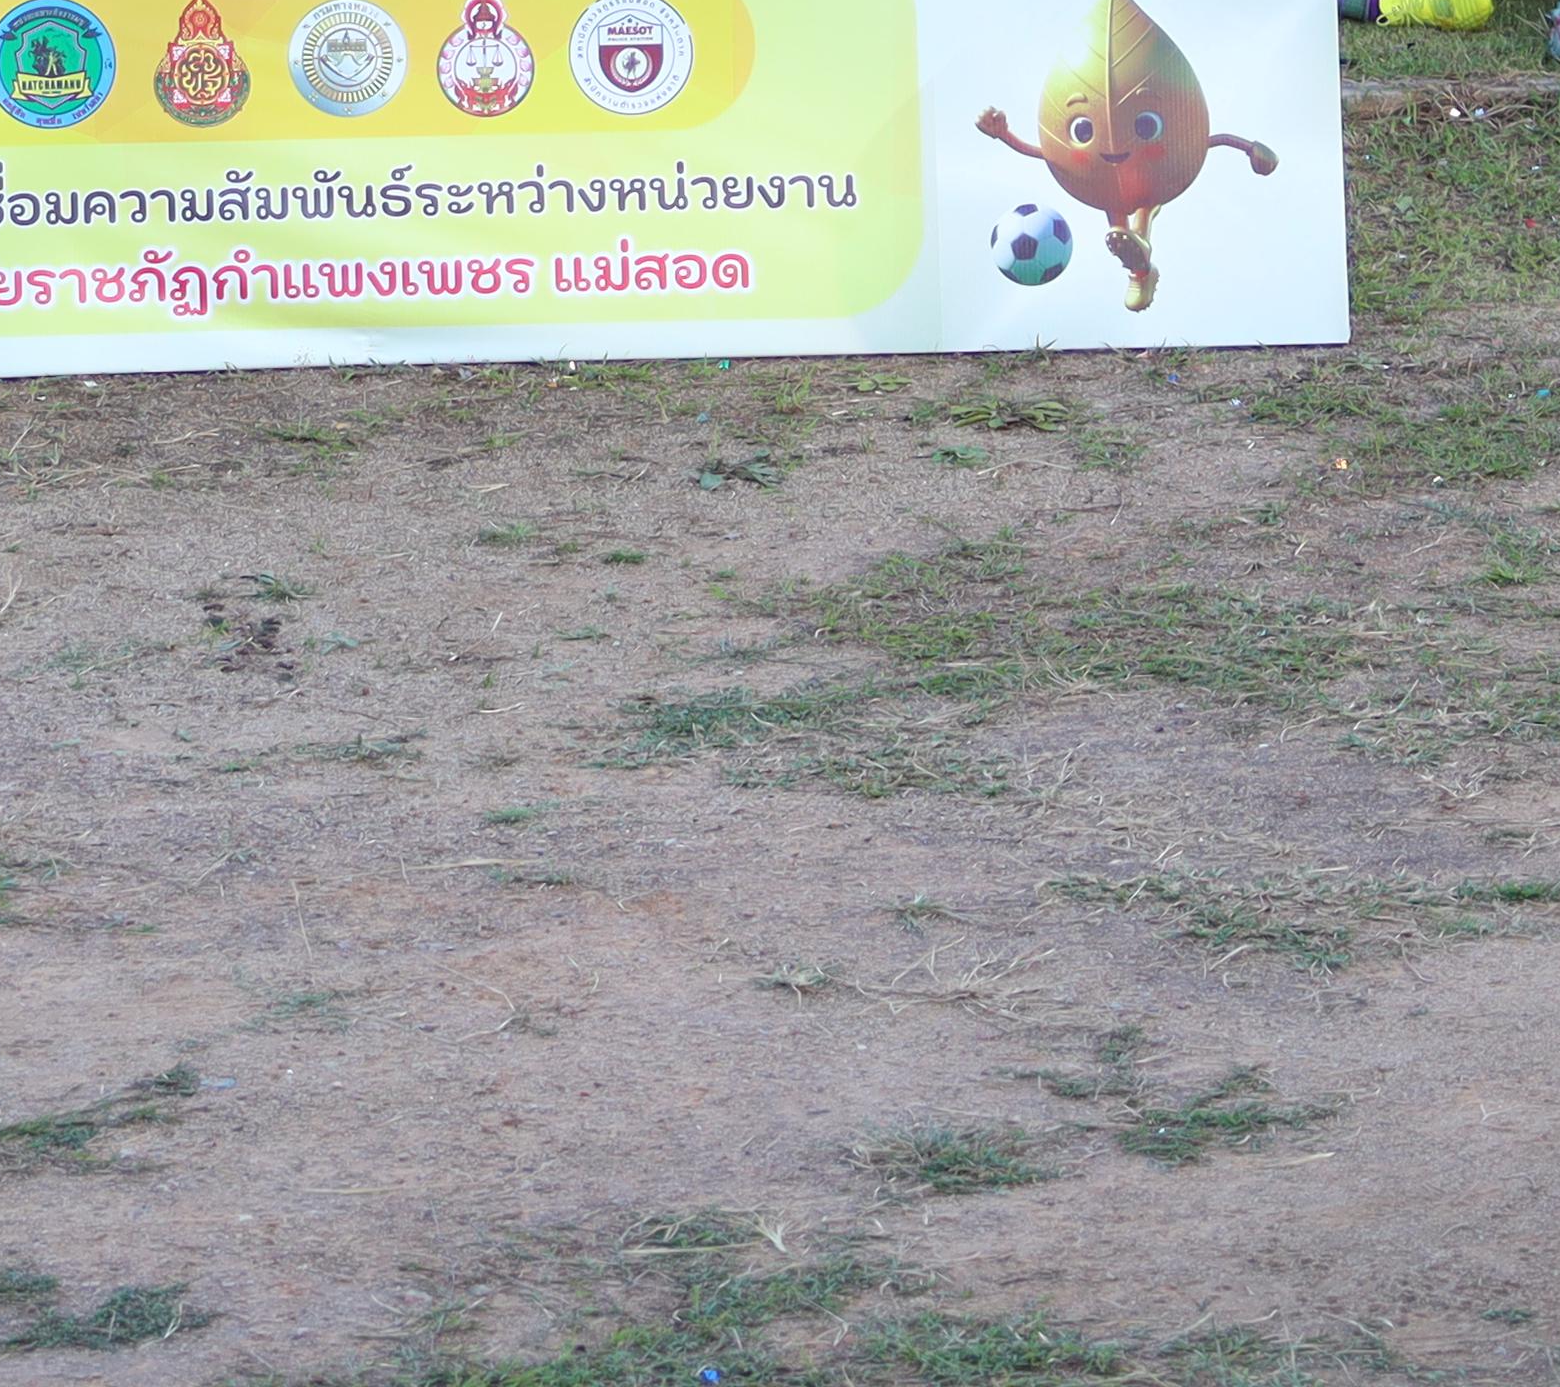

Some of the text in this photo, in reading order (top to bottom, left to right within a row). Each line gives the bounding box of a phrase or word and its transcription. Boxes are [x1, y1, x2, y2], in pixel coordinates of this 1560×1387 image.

[607, 25, 654, 36] MAESOT
[554, 238, 750, 294] แม่สอด
